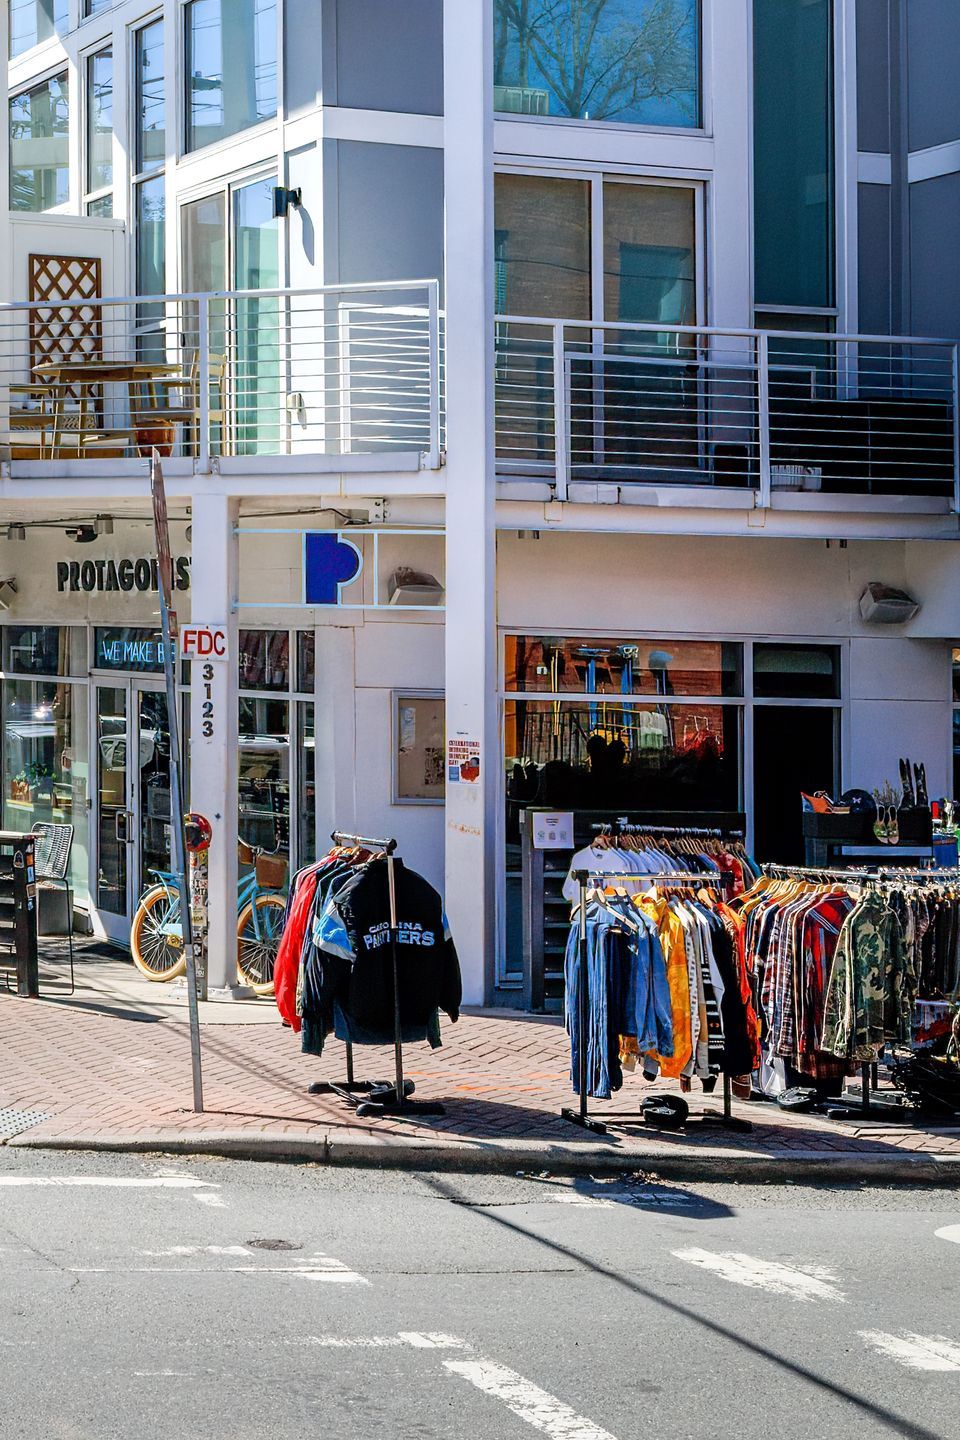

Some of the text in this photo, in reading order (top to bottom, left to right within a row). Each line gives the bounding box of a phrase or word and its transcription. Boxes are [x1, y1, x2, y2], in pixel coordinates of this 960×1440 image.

[57, 556, 192, 592] PROTAGOIS
[103, 640, 120, 661] WE
[123, 641, 153, 664] MAKE
[183, 630, 225, 656] FDC
[202, 663, 214, 738] 3123
[363, 929, 435, 950] PANTERS
